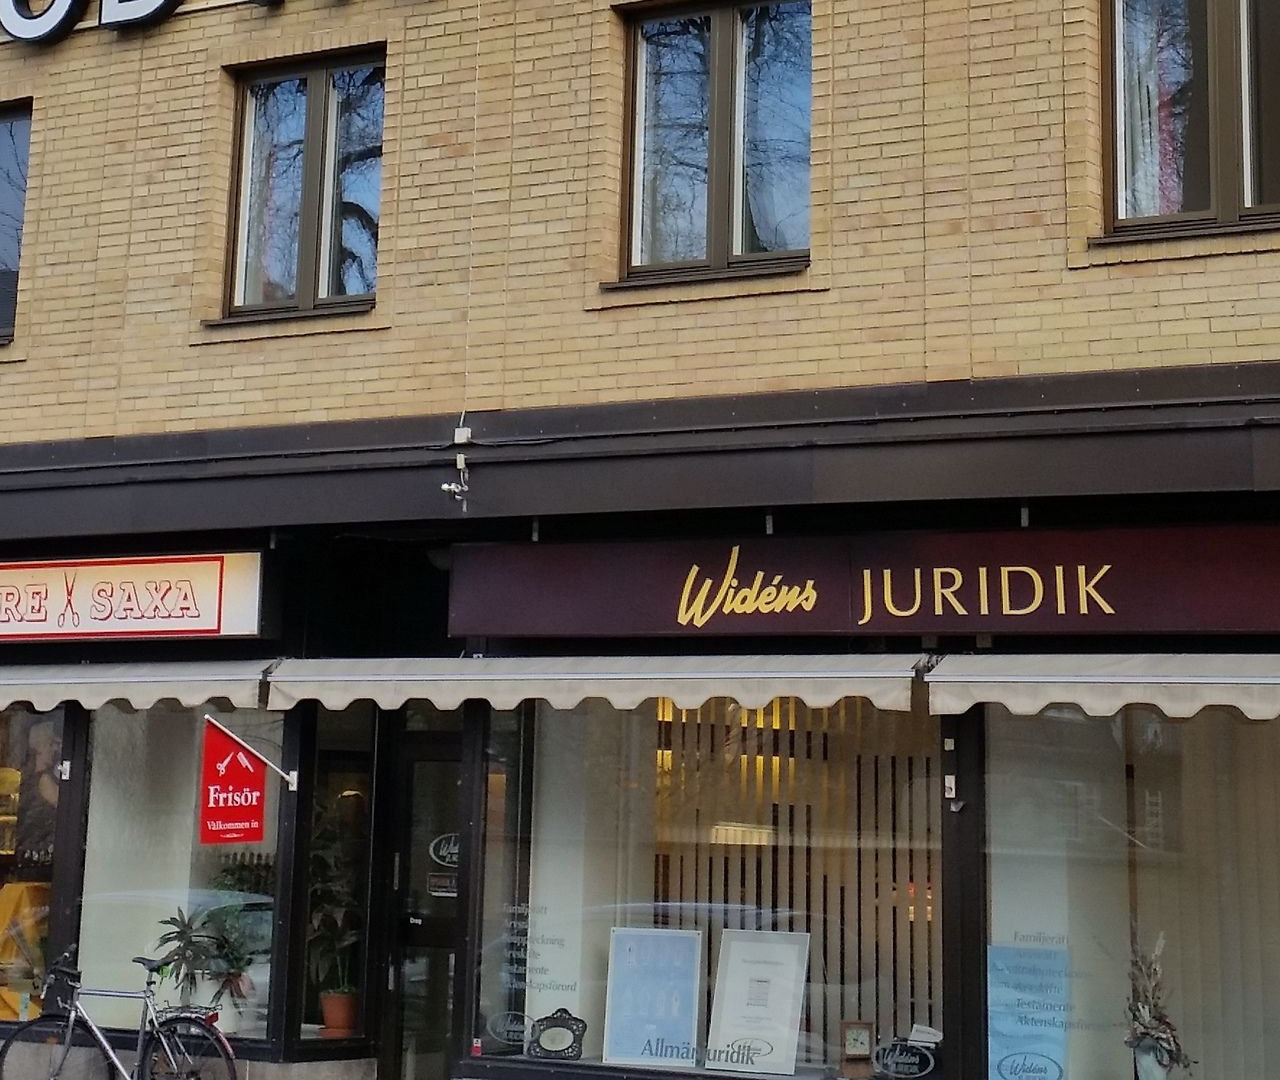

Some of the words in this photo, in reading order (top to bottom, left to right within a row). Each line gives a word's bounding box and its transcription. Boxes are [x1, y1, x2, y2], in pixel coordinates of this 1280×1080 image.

[90, 580, 201, 621] SAXA
[677, 544, 818, 628] Widéns
[857, 564, 1117, 625] JURIDIK
[207, 785, 261, 808] Frisör
[207, 820, 250, 831] Välkommen
[250, 819, 259, 829] in
